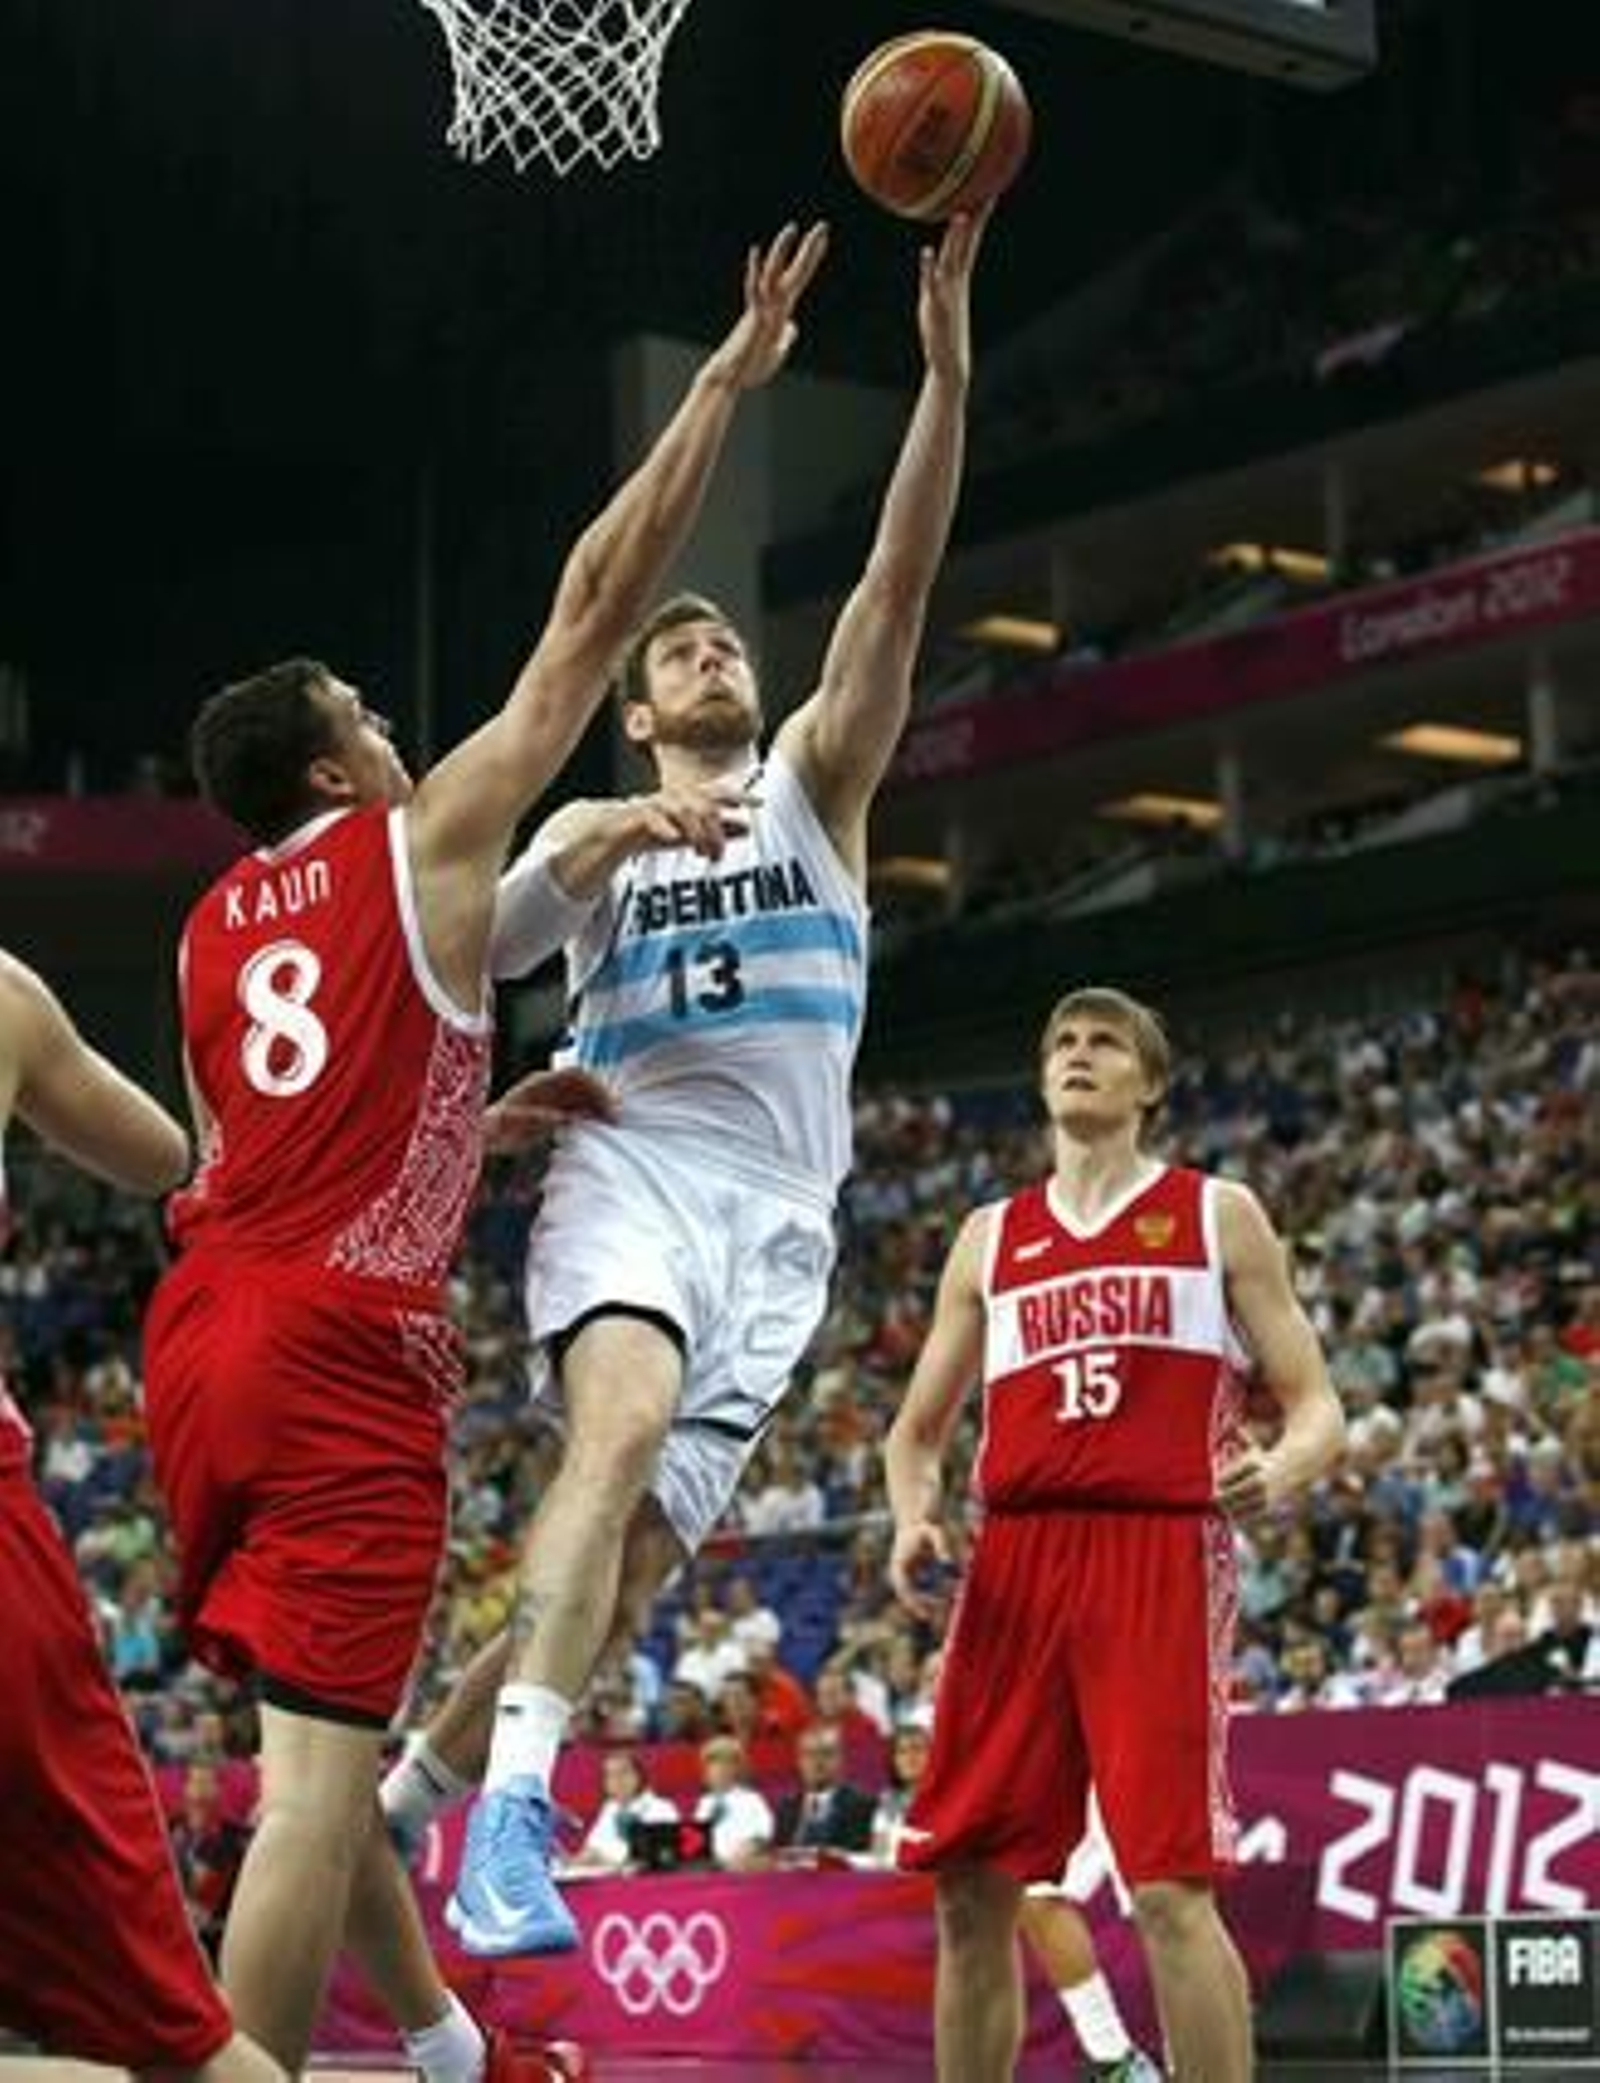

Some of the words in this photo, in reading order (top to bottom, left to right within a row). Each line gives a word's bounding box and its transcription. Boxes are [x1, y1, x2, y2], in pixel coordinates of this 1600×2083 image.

[238, 938, 328, 1097] 8
[664, 941, 747, 1019] 13
[1016, 1275, 1174, 1355] RUSSIA
[1051, 1353, 1121, 1421] 15
[1317, 1758, 1600, 1922] 2012
